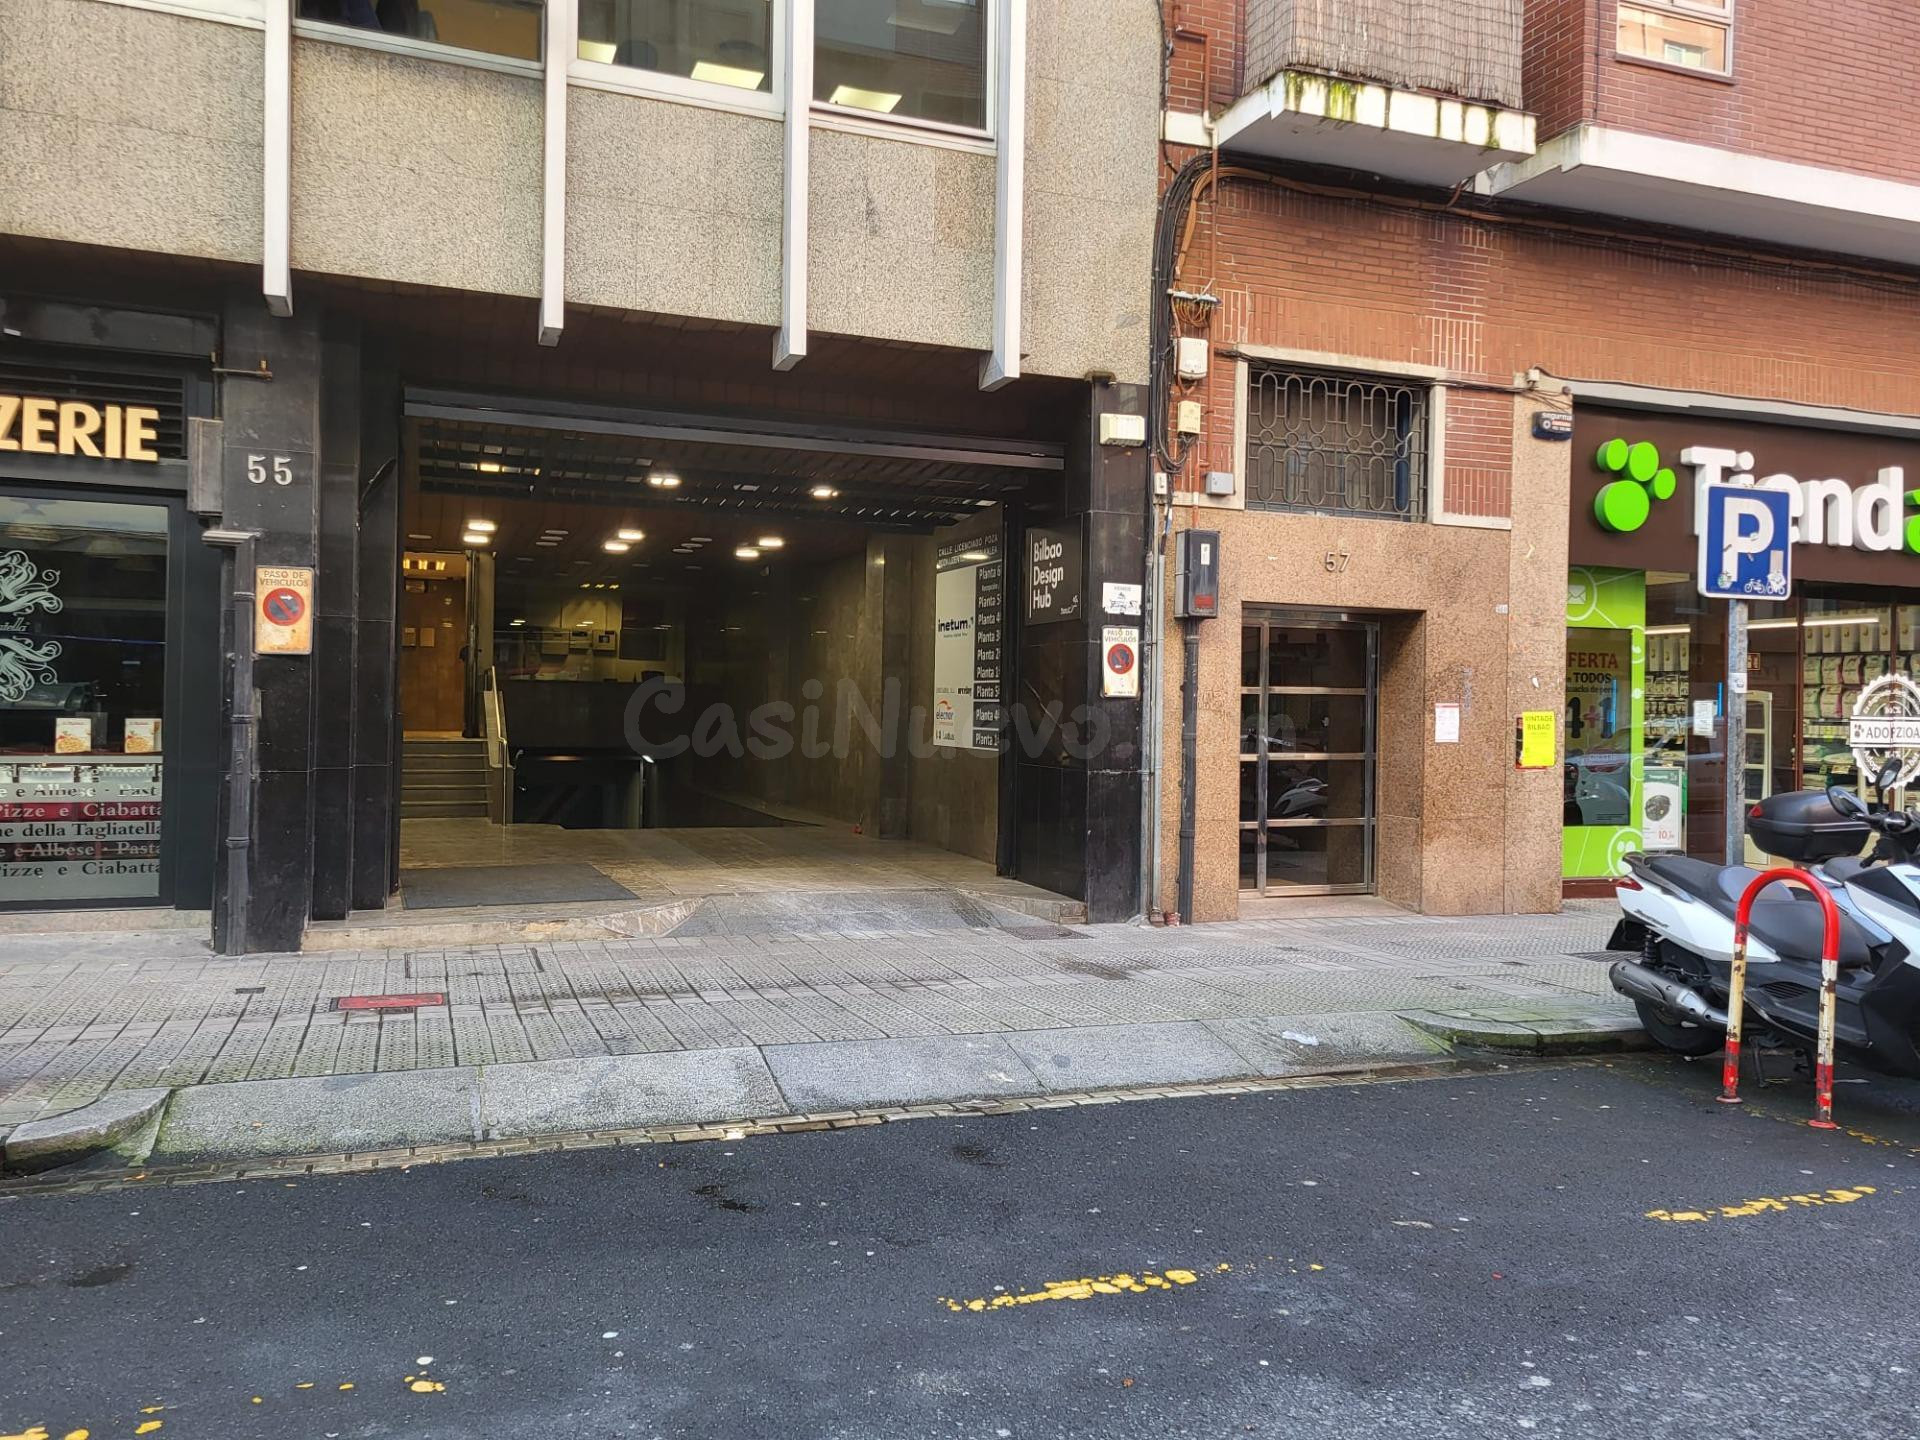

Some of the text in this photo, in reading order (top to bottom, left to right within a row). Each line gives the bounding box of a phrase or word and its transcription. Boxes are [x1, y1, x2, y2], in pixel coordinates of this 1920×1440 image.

[247, 455, 293, 486] 55
[1722, 496, 1775, 583] P
[1033, 537, 1063, 562] Bilbao
[1324, 552, 1351, 573] 57
[264, 570, 305, 579] PASO DE
[979, 567, 996, 581] Planta
[1033, 561, 1064, 589] Design
[260, 578, 309, 587] VEHICULOS
[979, 596, 996, 609] Planta
[1033, 585, 1052, 609] Hub
[978, 612, 996, 625] Planta
[977, 631, 995, 644] Planta
[977, 648, 995, 661] Planta
[1568, 652, 1618, 669] FERTA
[976, 666, 994, 679] Planta
[1573, 672, 1612, 684] TODOS
[976, 685, 994, 698] Planta
[975, 708, 994, 721] Planta
[975, 732, 993, 746] Planta
[59, 807, 70, 817] e
[22, 823, 66, 837] della
[14, 848, 24, 857] e
[32, 842, 95, 857] Albese
[0, 863, 44, 877] izze
[57, 866, 68, 876] e
